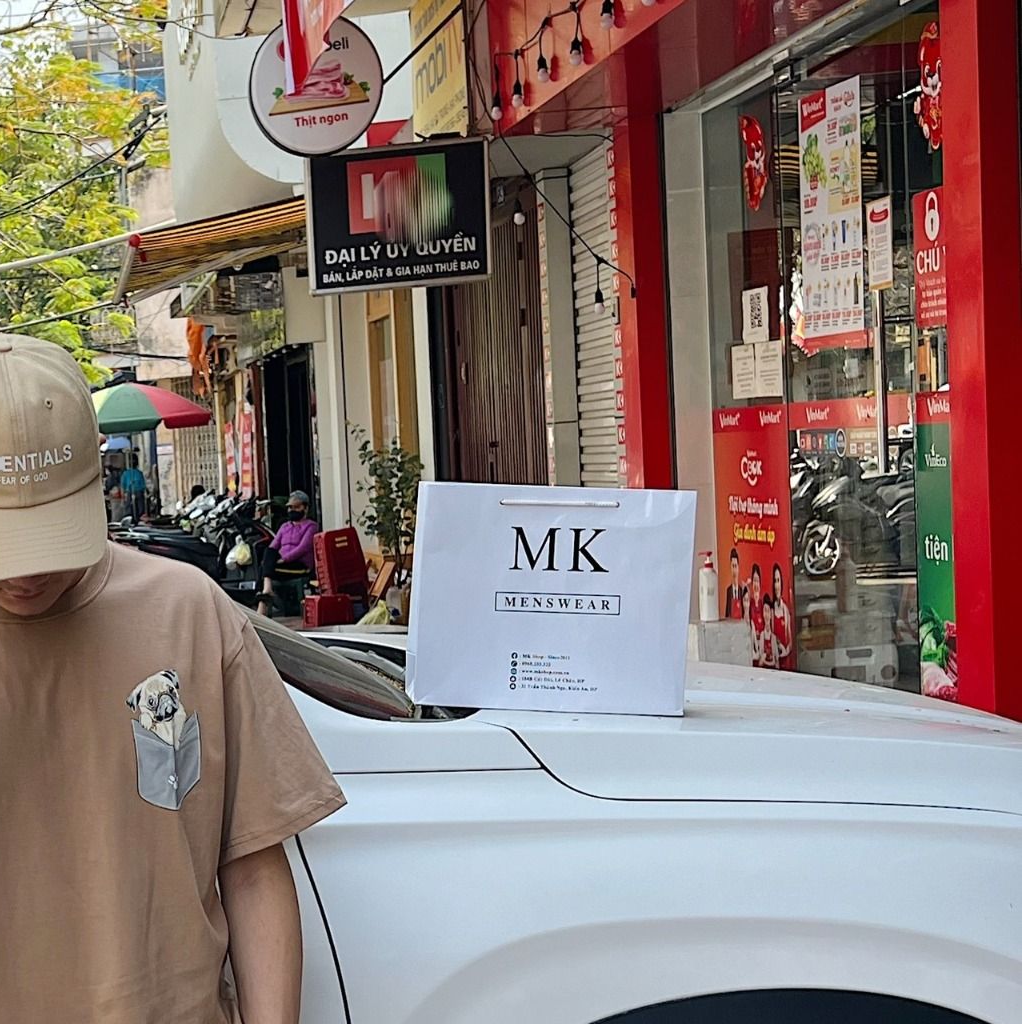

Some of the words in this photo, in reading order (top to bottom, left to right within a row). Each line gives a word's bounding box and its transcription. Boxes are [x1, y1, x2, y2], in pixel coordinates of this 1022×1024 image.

[295, 115, 317, 128] Thịt
[319, 113, 349, 126] ngon
[325, 248, 356, 267] ĐẠI
[360, 241, 381, 261] LÝ
[916, 241, 941, 275] CHÚ
[386, 267, 393, 277] &
[395, 266, 411, 276] GIA
[413, 264, 433, 277] HẠN
[435, 260, 458, 272] THUÊ
[460, 260, 480, 270] BAO
[927, 397, 950, 417] VinMa
[20, 475, 30, 485] OF
[33, 472, 48, 483] GOD
[509, 526, 609, 573] MK
[924, 534, 949, 566] tiện
[504, 595, 612, 611] MENSWEAR
